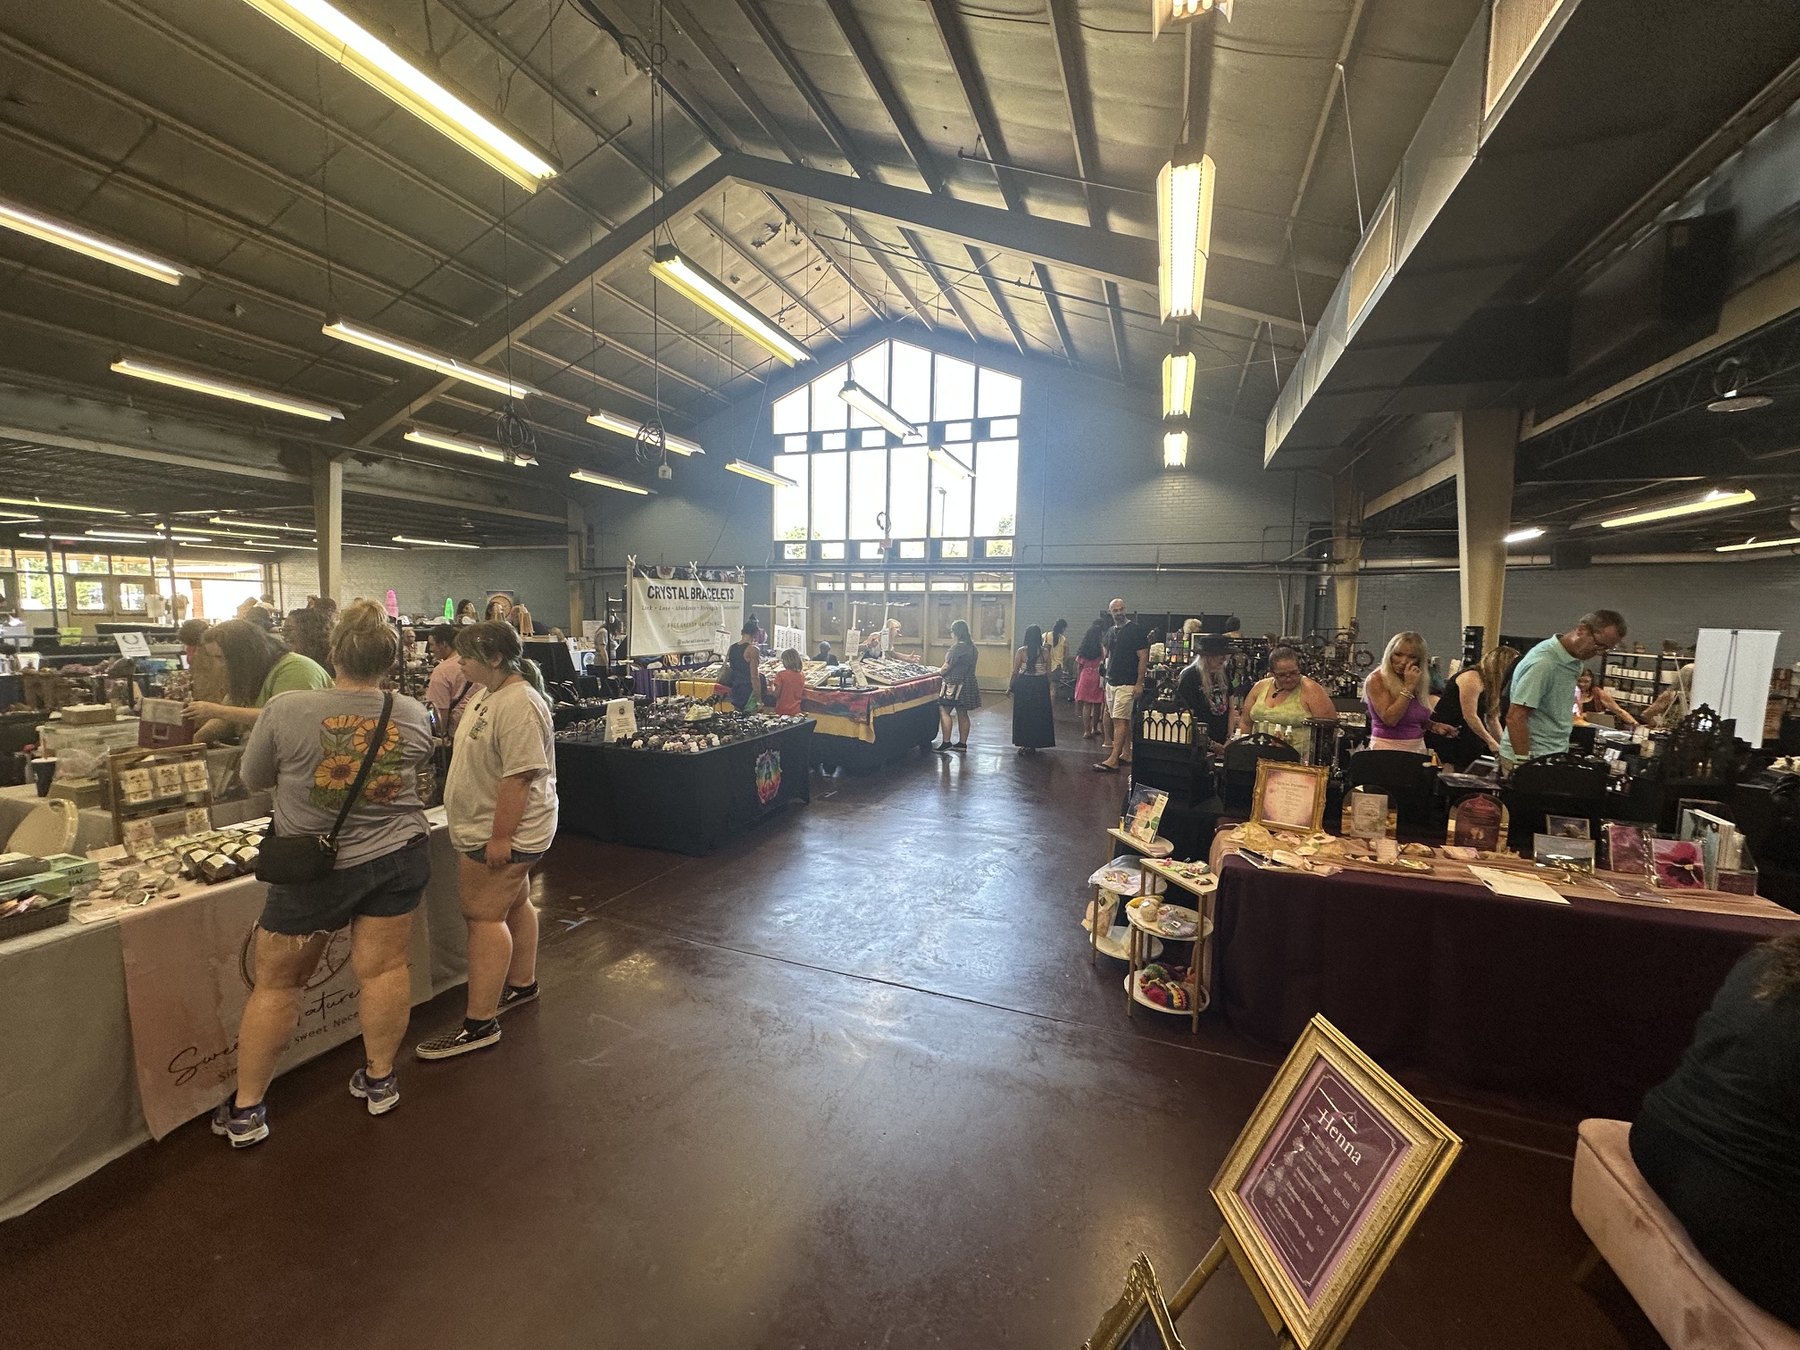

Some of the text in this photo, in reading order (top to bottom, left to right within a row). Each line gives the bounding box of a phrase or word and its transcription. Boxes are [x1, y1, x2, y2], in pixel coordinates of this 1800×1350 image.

[647, 585, 735, 600] CRYSTAL BRACELETS
[333, 1010, 361, 1027] Nece
[168, 1034, 240, 1086] Swee
[1317, 1108, 1363, 1166] Henna
